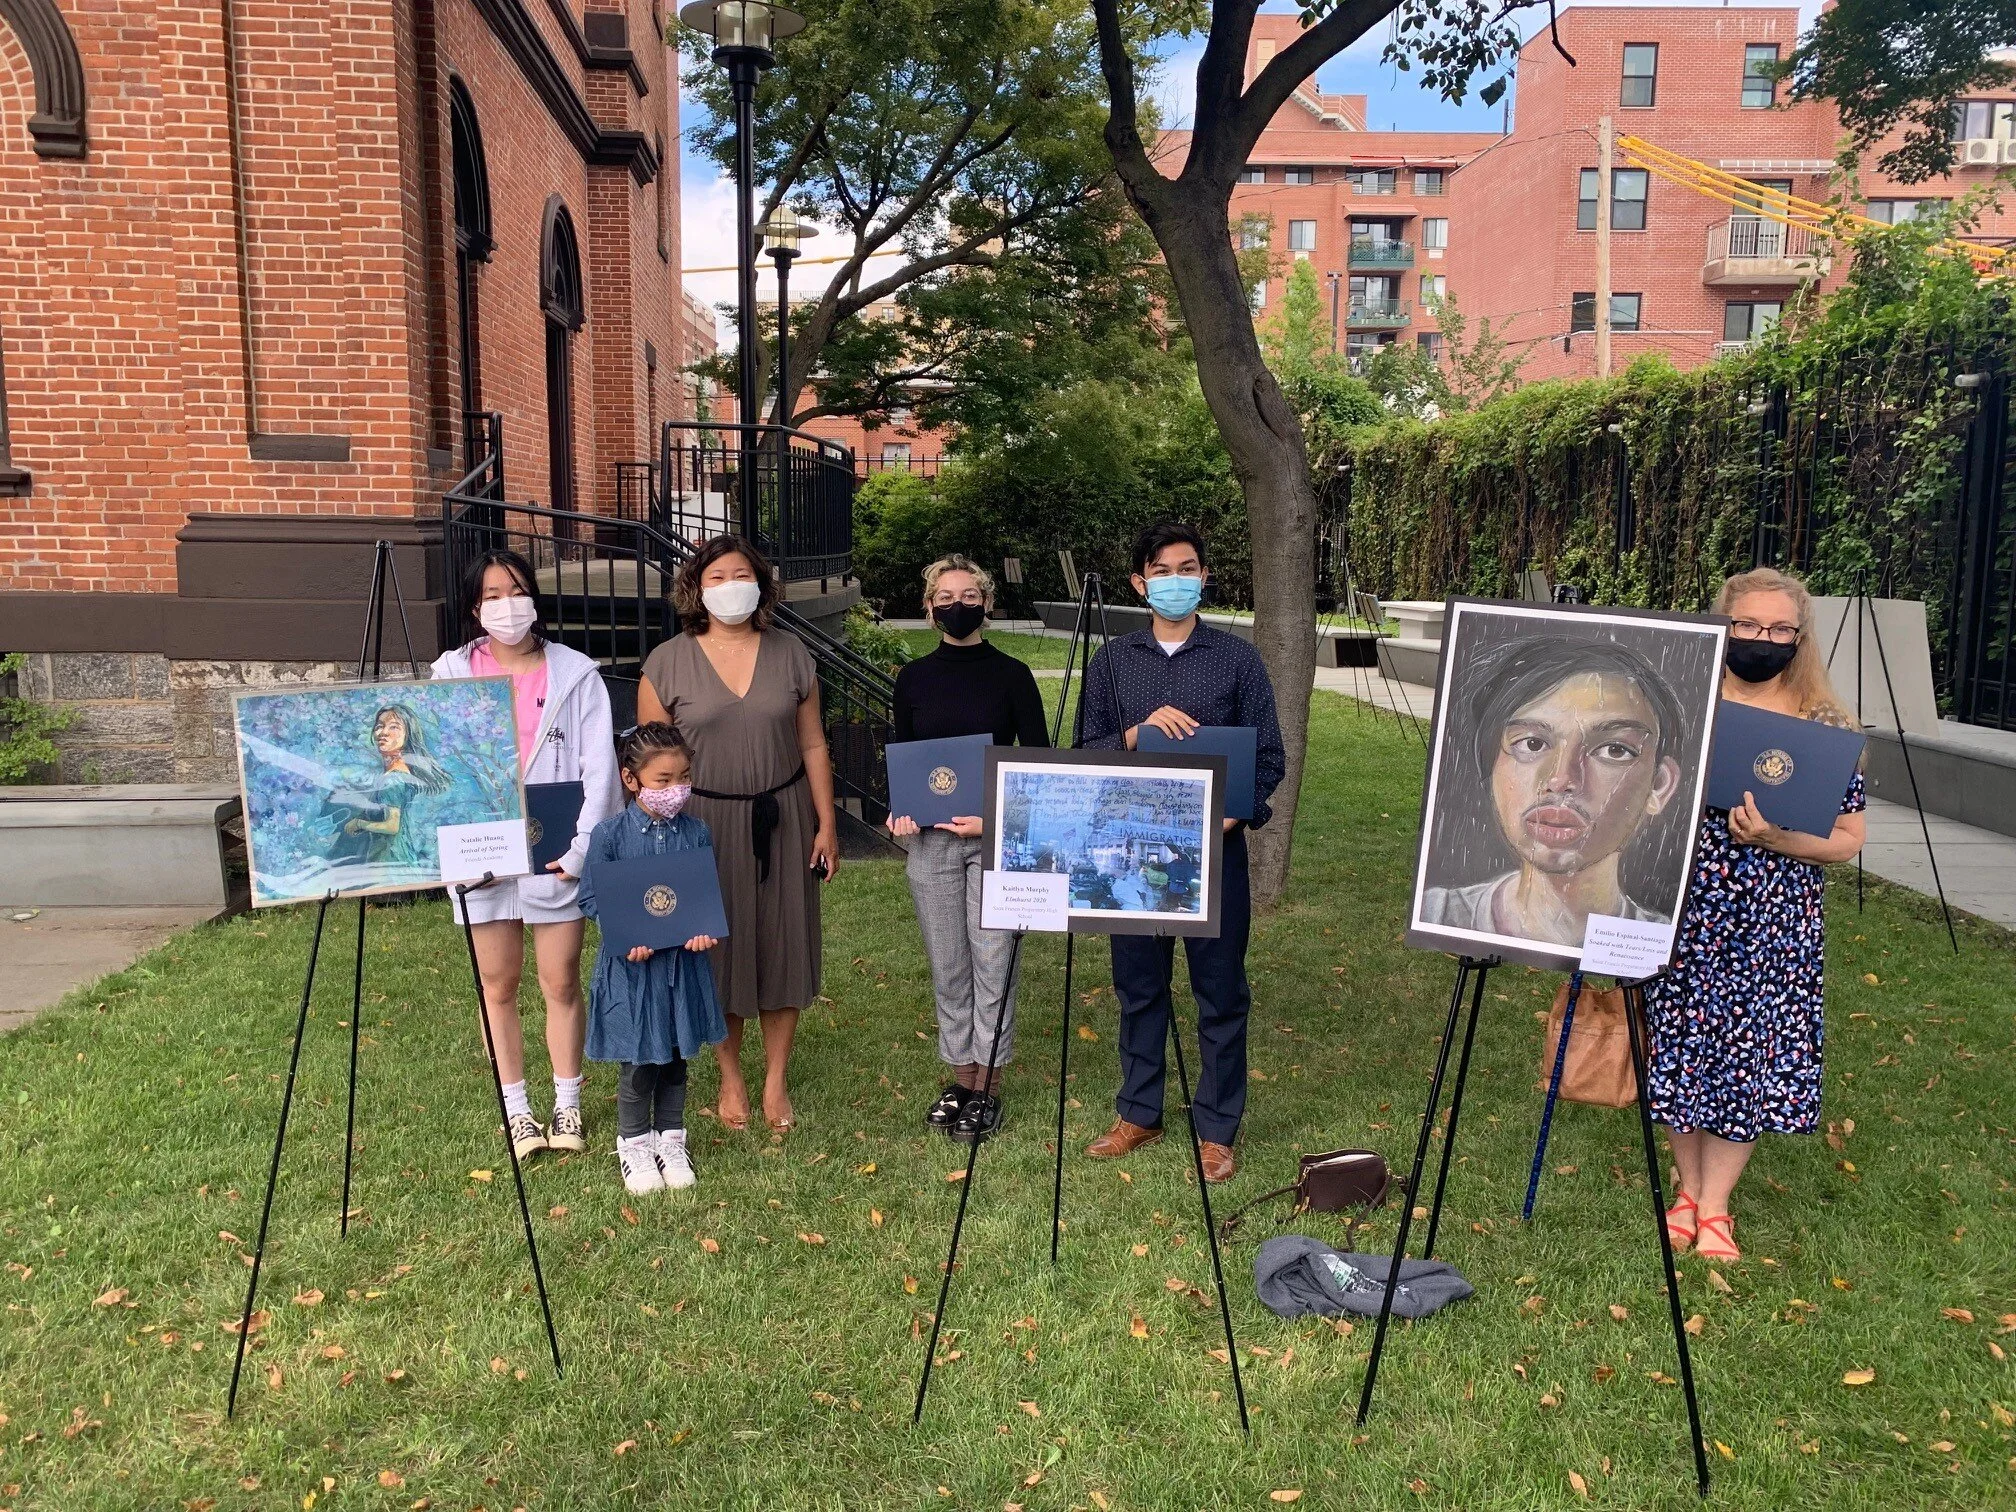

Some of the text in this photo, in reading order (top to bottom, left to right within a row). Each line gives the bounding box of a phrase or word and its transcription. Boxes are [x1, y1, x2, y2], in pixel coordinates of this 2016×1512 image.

[1026, 886, 1049, 894] Murphy
[1594, 928, 1666, 944] Emilio Espinal-Santiago
[1589, 939, 1610, 947] Soaked
[1609, 951, 1645, 961] Renaissance
